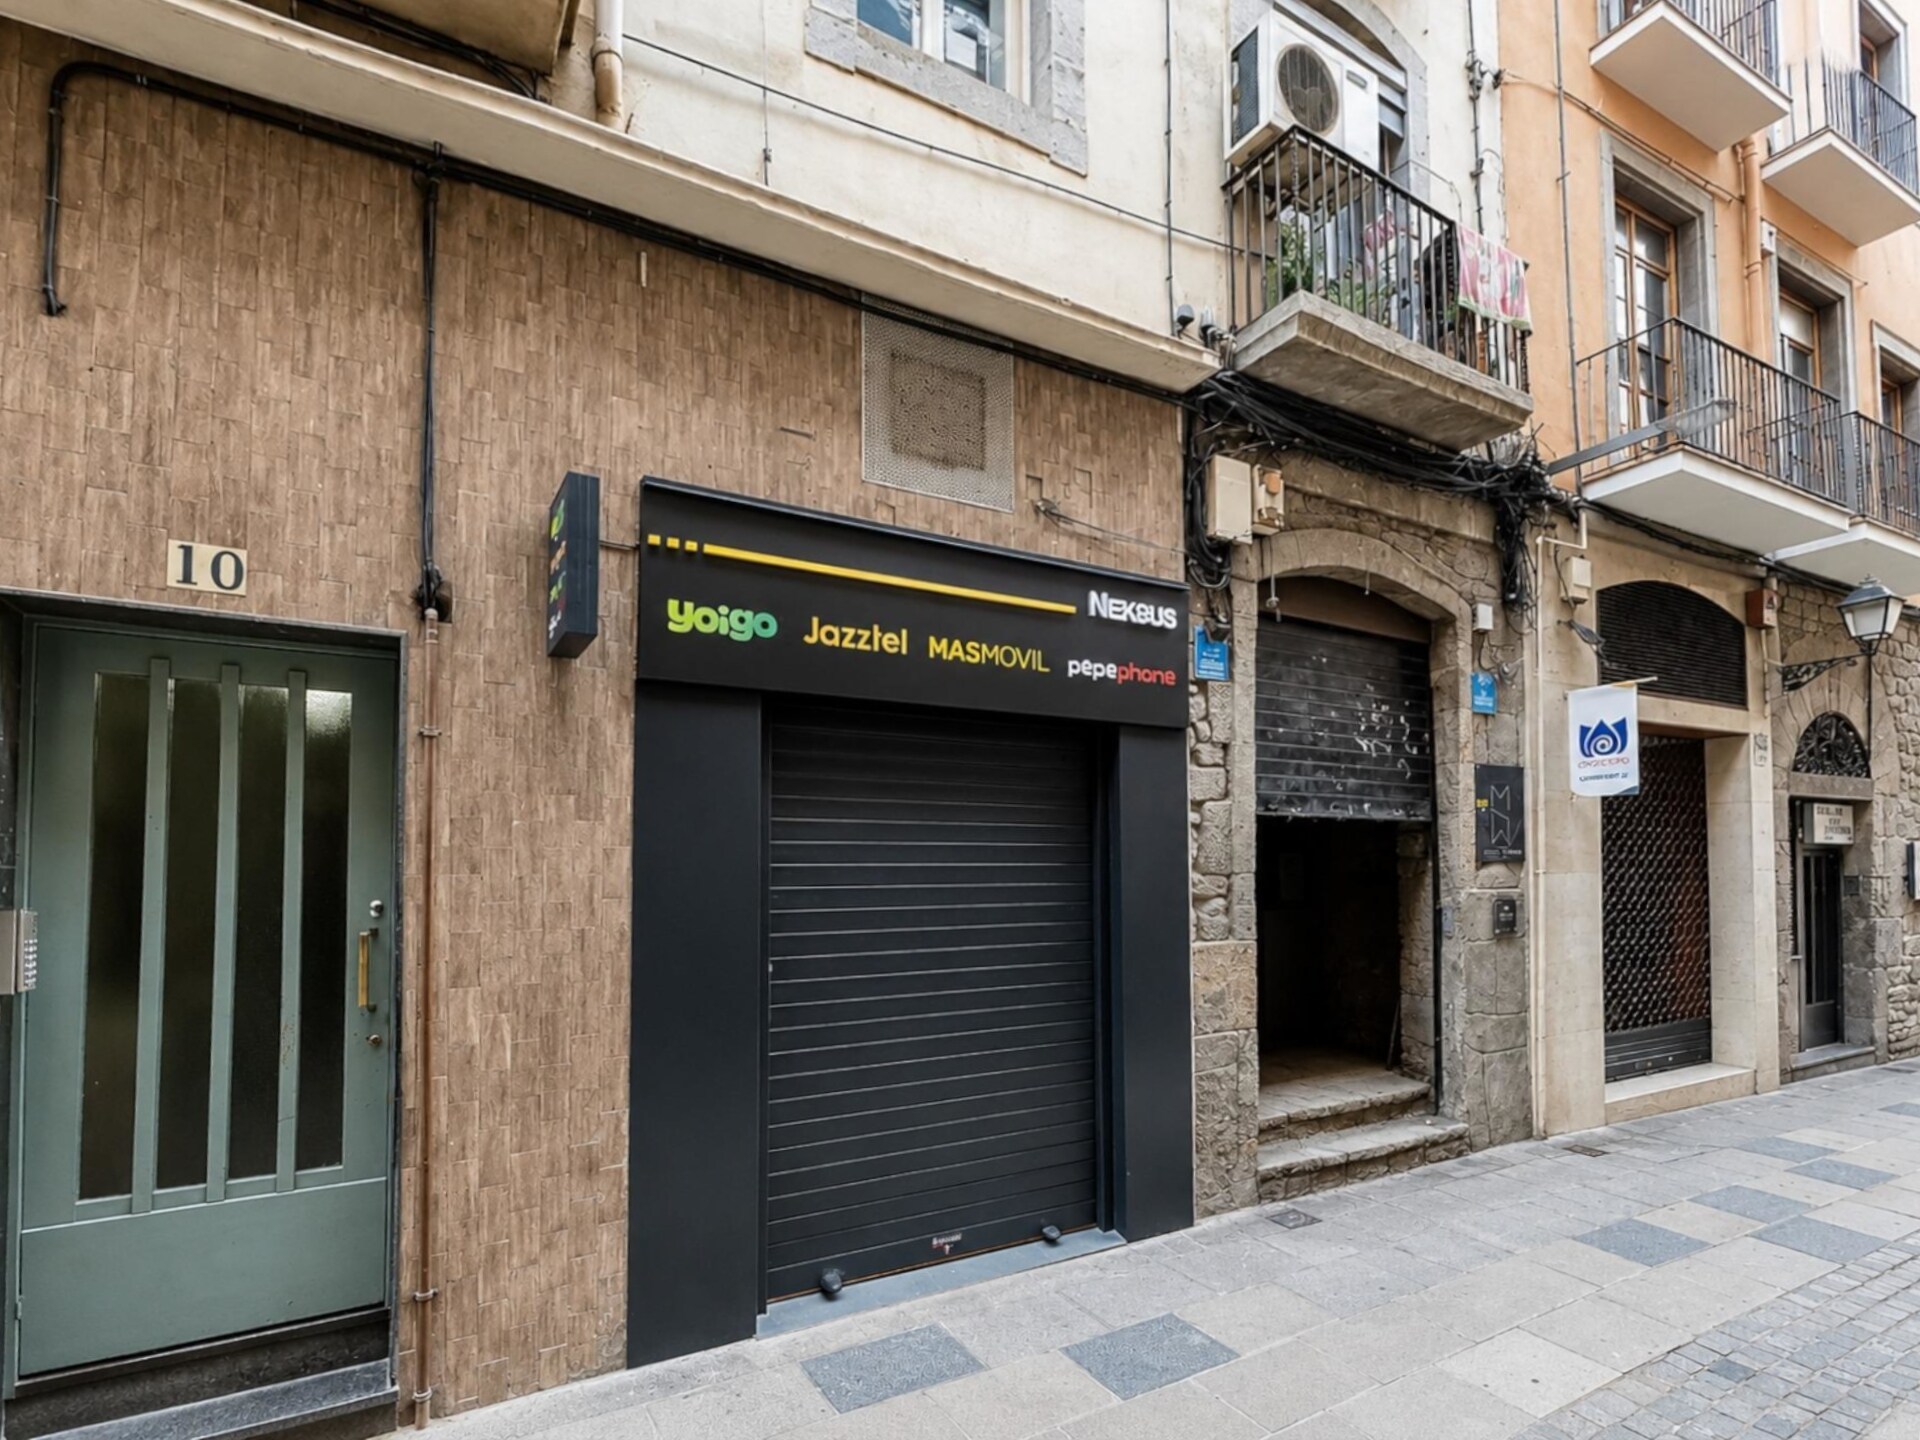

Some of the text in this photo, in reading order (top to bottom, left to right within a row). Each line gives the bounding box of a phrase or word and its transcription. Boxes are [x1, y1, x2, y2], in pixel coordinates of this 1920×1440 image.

[176, 544, 244, 591] 10
[667, 598, 778, 642] yoigo
[803, 616, 908, 655] Jazztel
[928, 635, 1051, 672] MASMOVIL
[1067, 658, 1176, 686] pepephone
